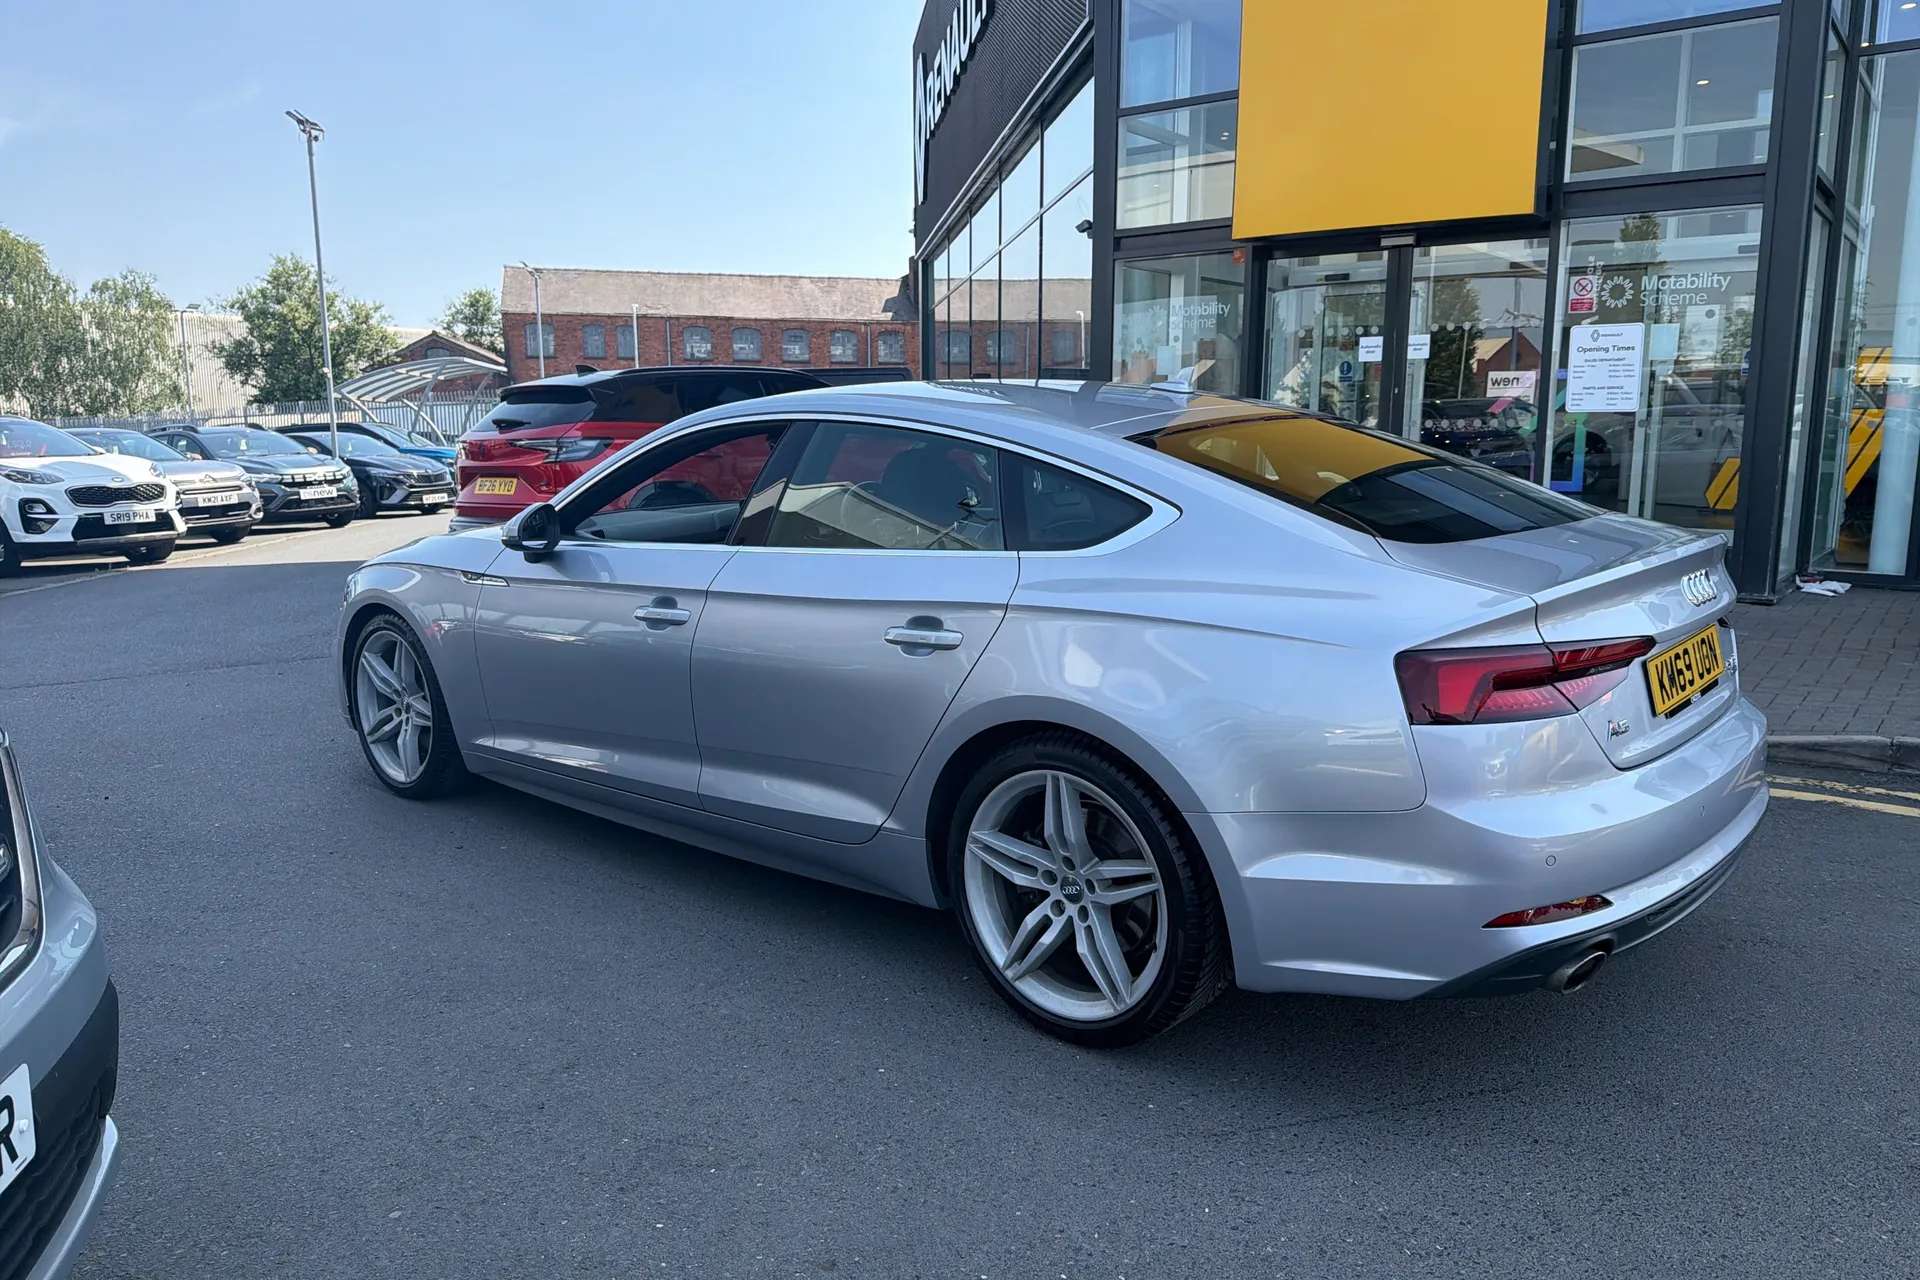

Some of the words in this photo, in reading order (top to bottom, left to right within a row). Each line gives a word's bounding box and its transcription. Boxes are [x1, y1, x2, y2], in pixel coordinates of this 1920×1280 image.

[926, 0, 986, 139] RENAUL
[1641, 272, 1732, 292] Motability
[1640, 291, 1707, 307] Scheme
[1171, 302, 1230, 317] Motability
[1576, 345, 1610, 354] Opening
[1611, 344, 1635, 352] Times
[110, 512, 131, 523] SR19
[132, 511, 150, 521] PHA
[1655, 648, 1695, 704] KM69
